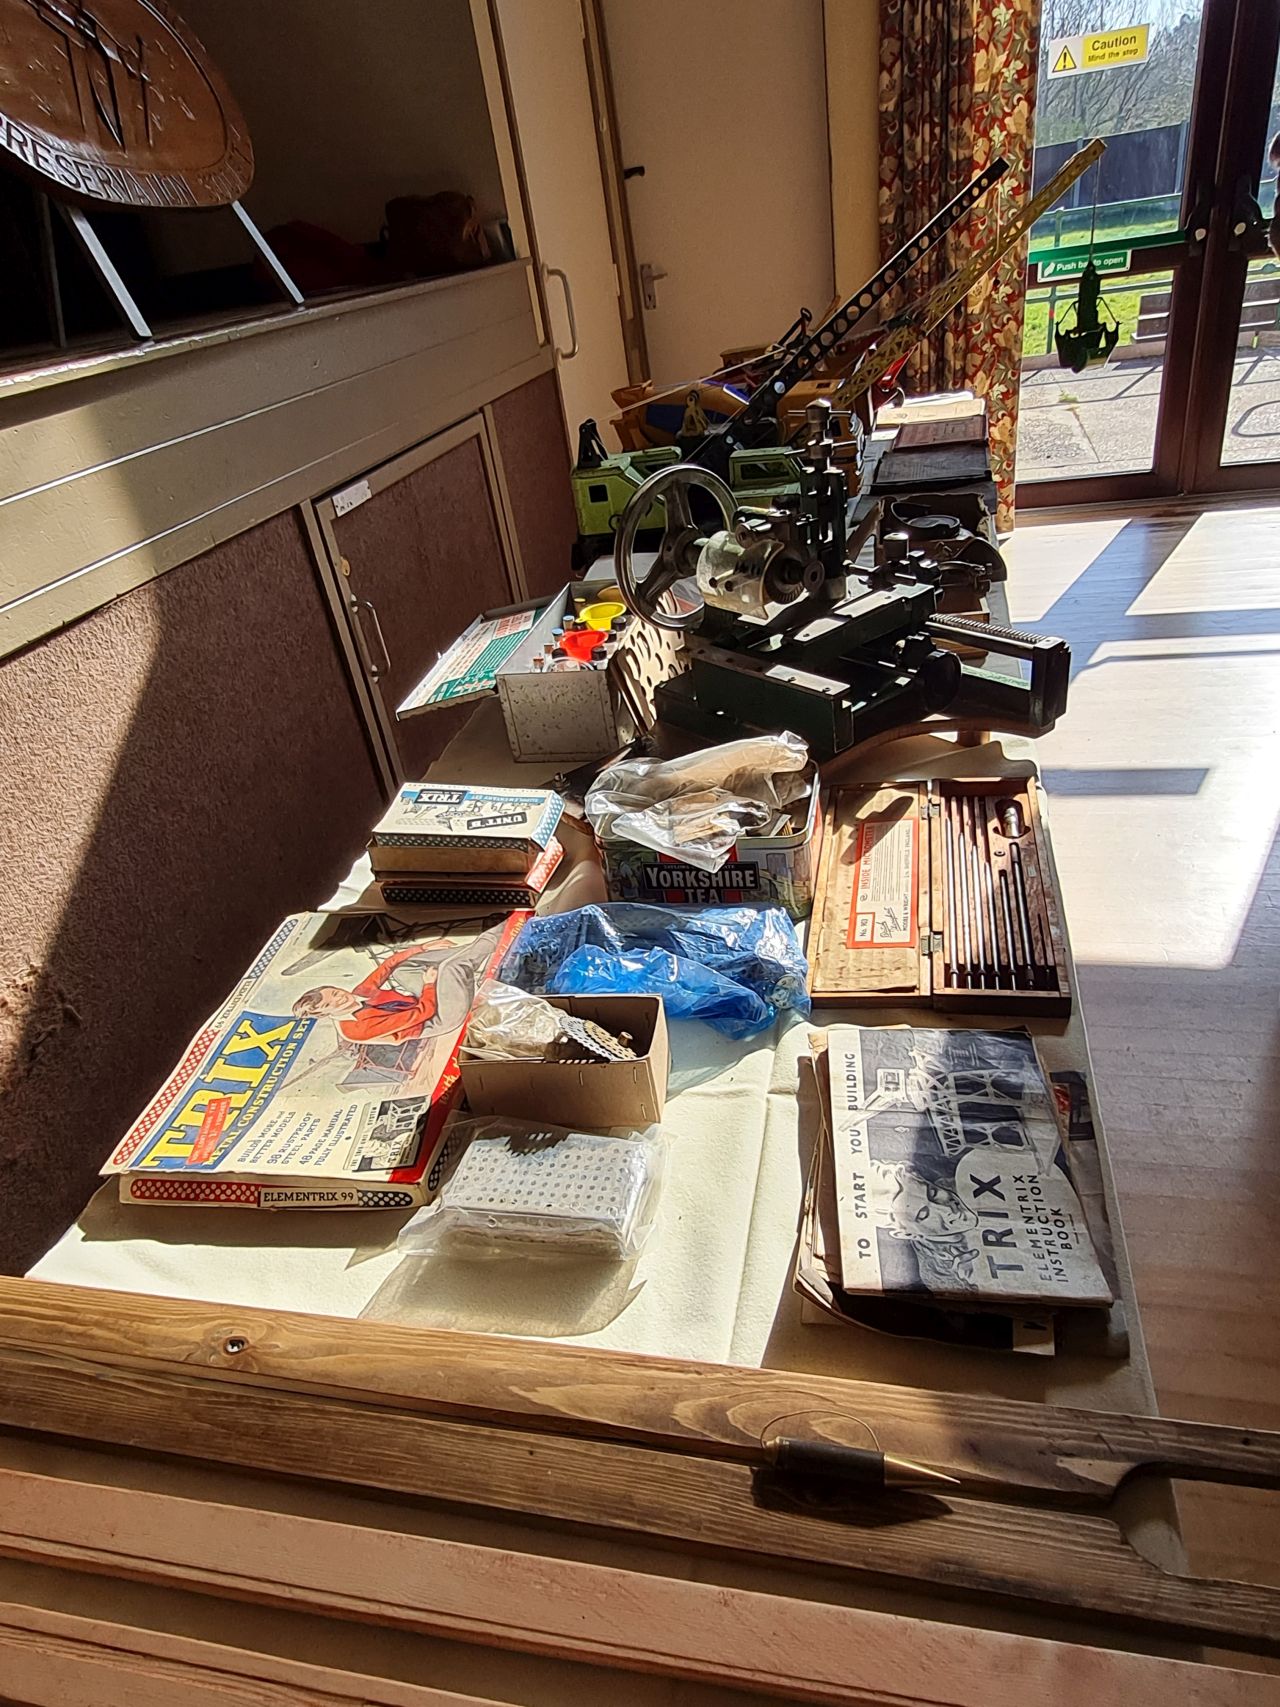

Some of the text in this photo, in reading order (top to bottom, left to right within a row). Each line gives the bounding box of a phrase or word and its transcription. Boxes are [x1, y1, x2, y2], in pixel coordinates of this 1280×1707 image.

[1088, 48, 1139, 62] Mind the step
[1092, 35, 1136, 51] Caution
[0, 116, 199, 206] RESERVATION
[1056, 262, 1077, 271] Push
[1103, 257, 1124, 266] open
[420, 793, 460, 803] TRIX
[486, 815, 523, 827] UNIT
[646, 867, 756, 888] YORKSHIRE
[685, 889, 720, 905] TEA
[860, 868, 871, 890] INSIDE
[138, 1019, 297, 1167] TRIX
[237, 1041, 299, 1128] CONSTRUCTION
[292, 1018, 311, 1040] SET
[249, 1111, 297, 1164] BETTER MODELS
[259, 1120, 278, 1138] MORE
[266, 1112, 313, 1165] 98 RUSTPROOF
[281, 1118, 321, 1165] STEEL PARTS
[299, 1108, 343, 1165] 48 PAGE MANUAL
[314, 1104, 358, 1166] FULLY ILLUSTRATED
[387, 1140, 403, 1164] TRIX
[844, 1053, 872, 1259] TO START YOU BUILDING
[264, 1191, 354, 1203] ELEMENTRIX 99
[969, 1173, 1025, 1279] TRIX
[1012, 1174, 1053, 1281] ELEMENTRIX
[1026, 1174, 1070, 1283] INSTRUCTION
[1050, 1207, 1073, 1250] BOOK
